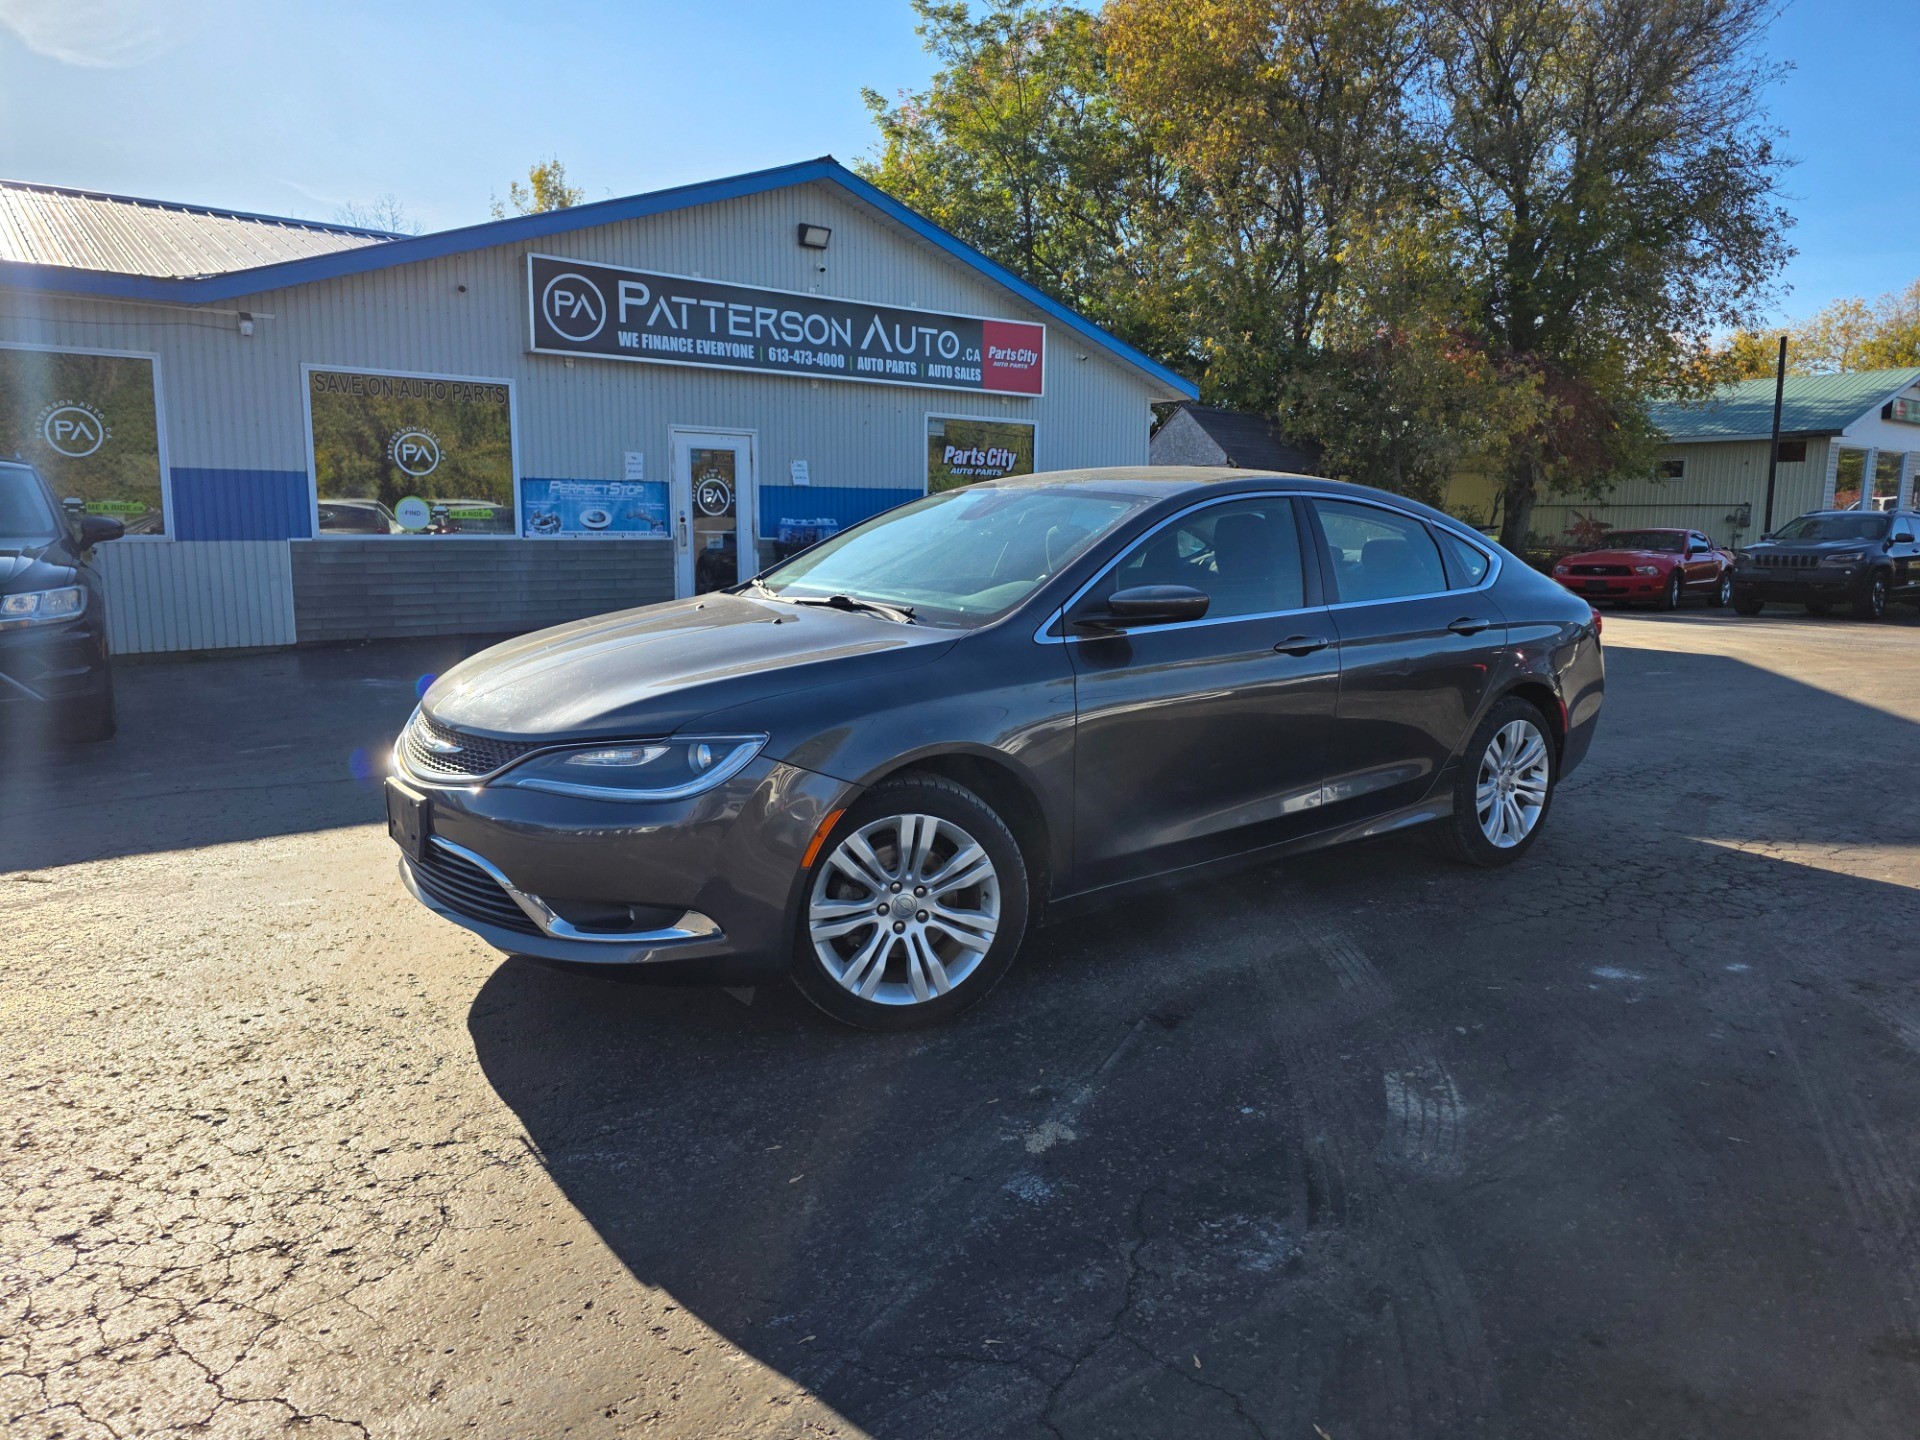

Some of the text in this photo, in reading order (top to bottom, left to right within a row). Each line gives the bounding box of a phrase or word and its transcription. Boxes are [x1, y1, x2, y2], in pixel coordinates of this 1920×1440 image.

[554, 289, 597, 321] PA
[617, 280, 851, 348] PATTERSON
[860, 313, 960, 360] AUTO
[618, 331, 982, 382] WE FINANCE EVERYONE 613-473-4000 AUTO PARTS AUTO SALES
[314, 373, 506, 404] SAVE ON AUTO PARTS
[54, 420, 95, 440] PA
[402, 443, 433, 462] PA
[950, 467, 1002, 476] AUTO PARTS
